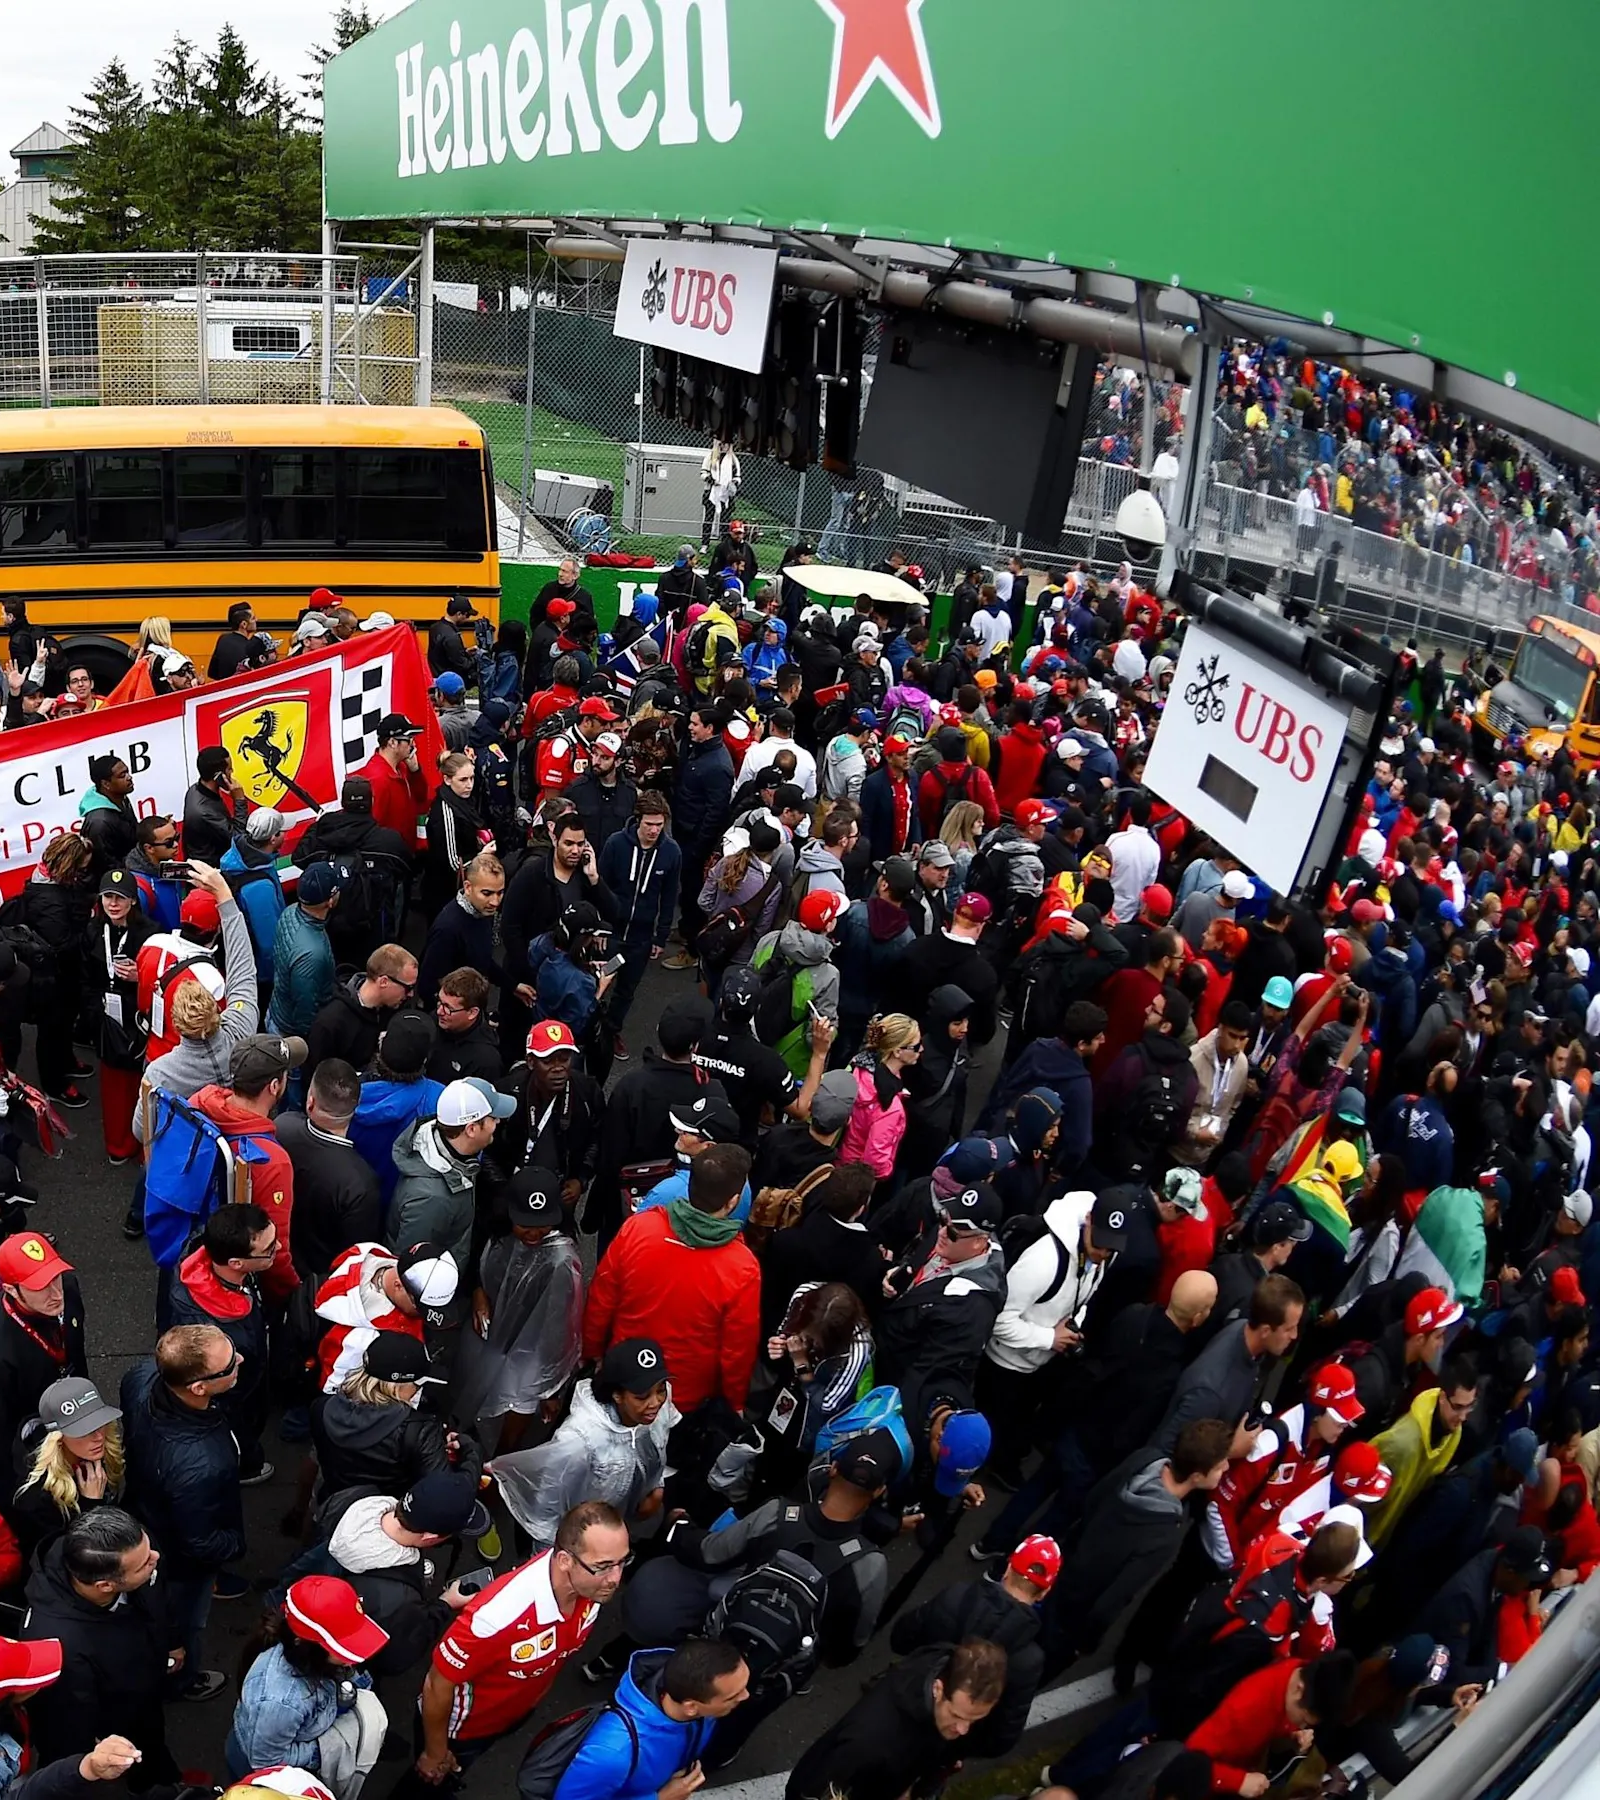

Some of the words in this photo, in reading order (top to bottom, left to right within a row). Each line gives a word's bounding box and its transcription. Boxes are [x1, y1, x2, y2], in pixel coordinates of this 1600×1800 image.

[396, 0, 742, 178] Heineken
[671, 267, 737, 335] UBS
[1234, 682, 1324, 783] UBS
[691, 1053, 746, 1078] PETRONAS
[427, 1308, 444, 1326] 14
